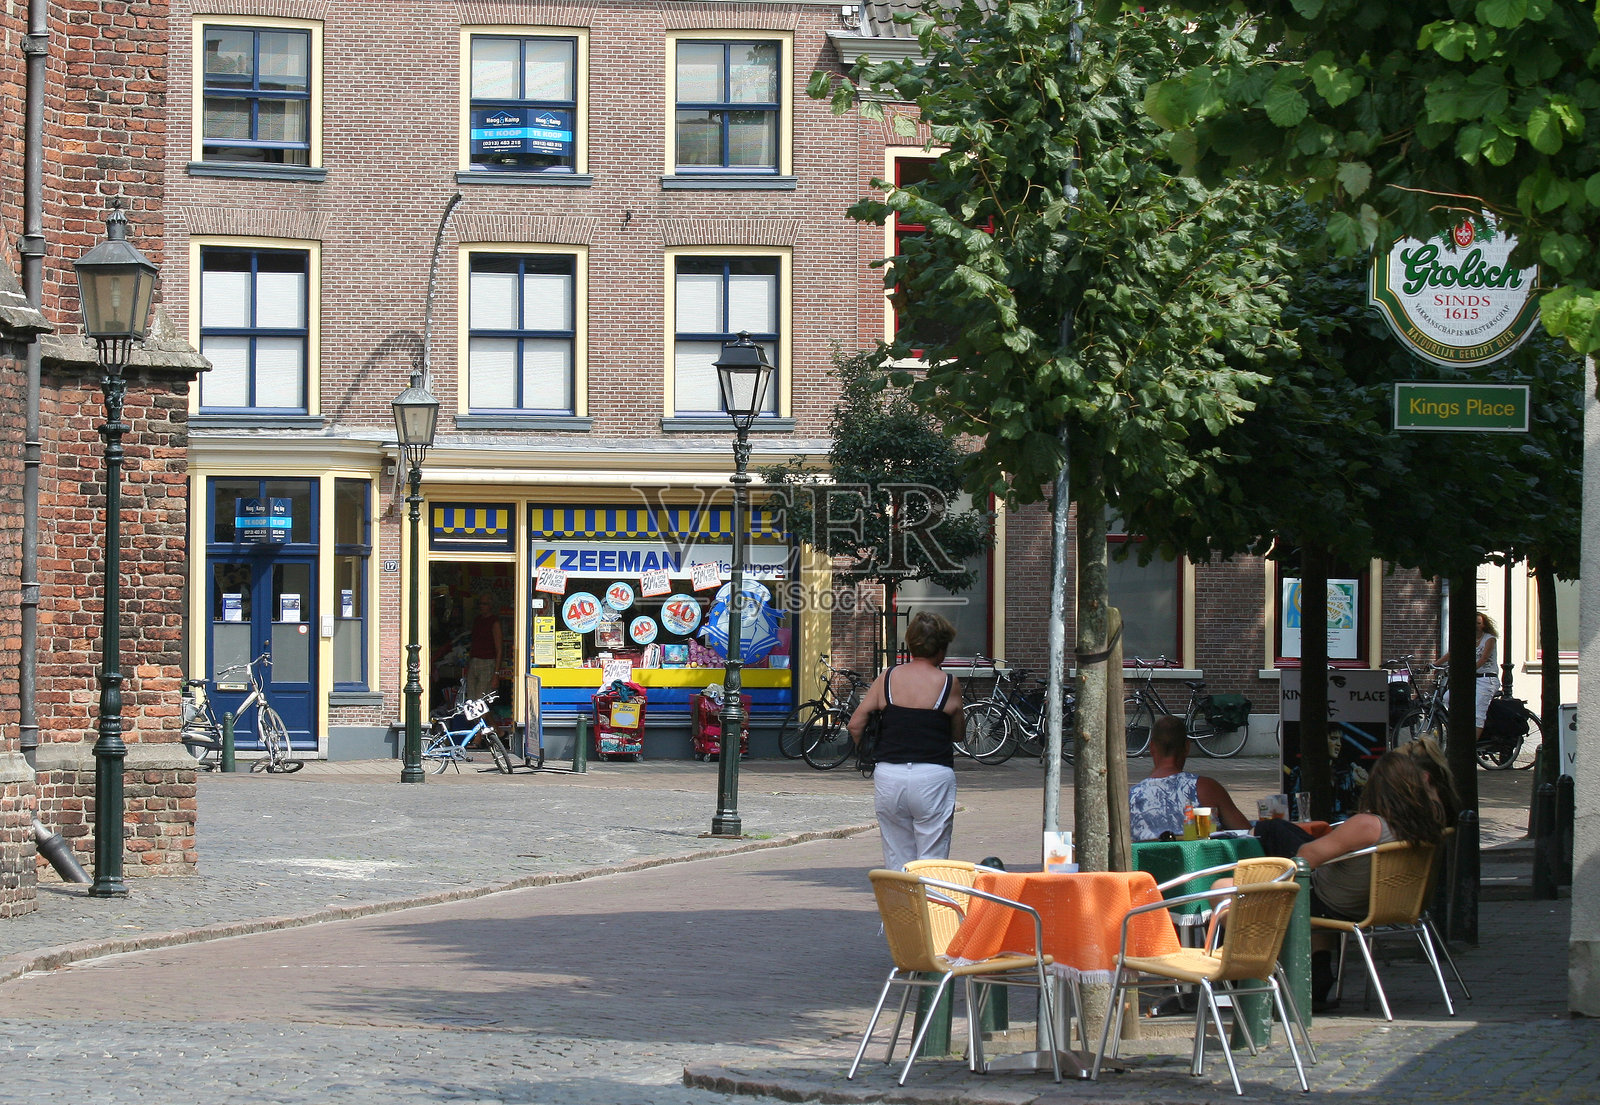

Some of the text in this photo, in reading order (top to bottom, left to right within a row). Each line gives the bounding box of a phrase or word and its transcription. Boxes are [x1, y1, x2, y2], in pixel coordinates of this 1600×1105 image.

[1400, 244, 1523, 295] Grolsch
[1434, 294, 1491, 307] SINDS
[1415, 303, 1456, 336] VAKMANSCHAP
[1465, 304, 1510, 336] MEESTERSCHAP
[1445, 308, 1479, 320] 1615
[1406, 327, 1516, 359] NATUURLIJK GERIJPT BIER
[1409, 398, 1516, 419] Kings Place
[386, 562, 396, 570] 17
[560, 550, 681, 572] ZEEMAN
[609, 587, 630, 601] 40
[567, 600, 595, 620] 40
[667, 601, 695, 623] 40
[634, 621, 651, 637] 40
[1349, 691, 1385, 701] PLACE
